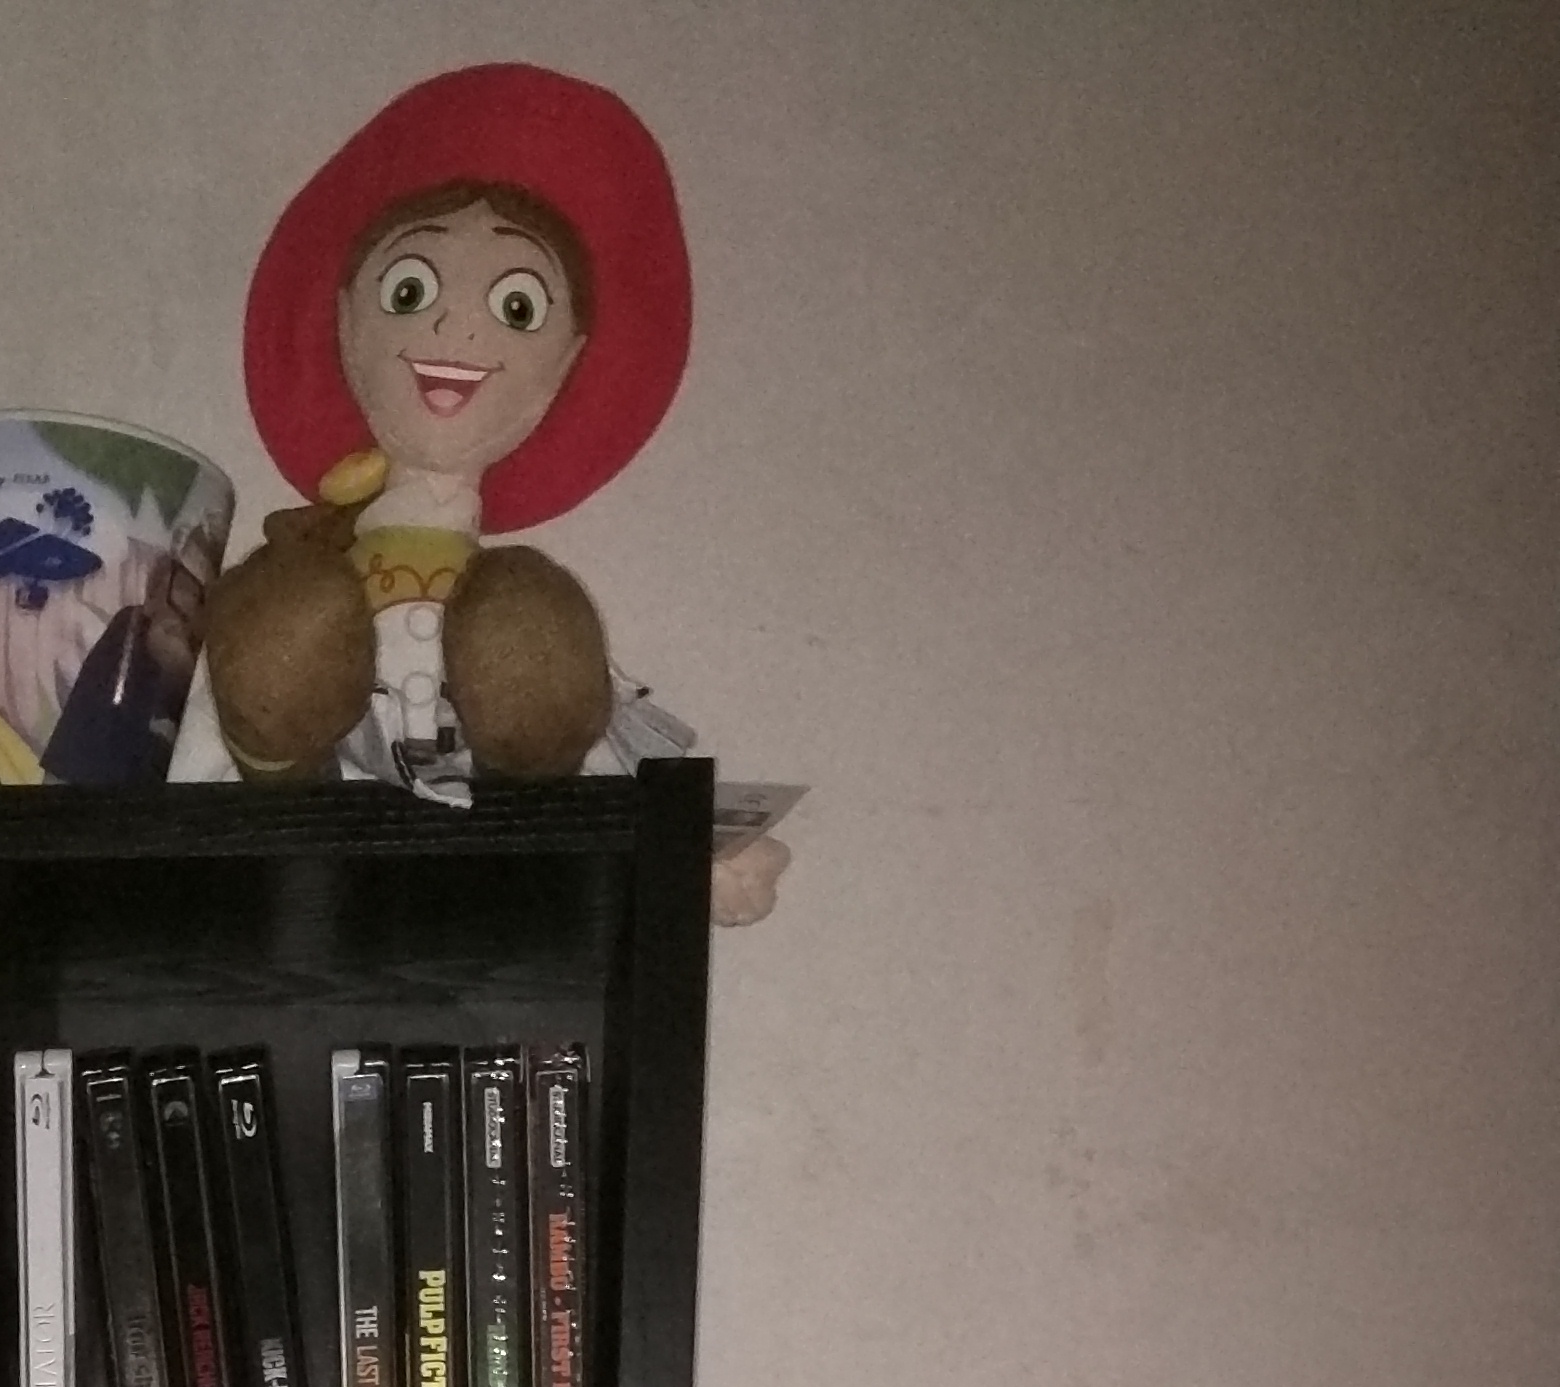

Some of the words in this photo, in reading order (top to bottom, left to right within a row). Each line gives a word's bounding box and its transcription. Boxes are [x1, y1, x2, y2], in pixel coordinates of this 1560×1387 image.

[354, 1304, 379, 1339] THE
[418, 1269, 446, 1335] PULP
[357, 1345, 380, 1386] LAST
[550, 1311, 571, 1376] FIRST
